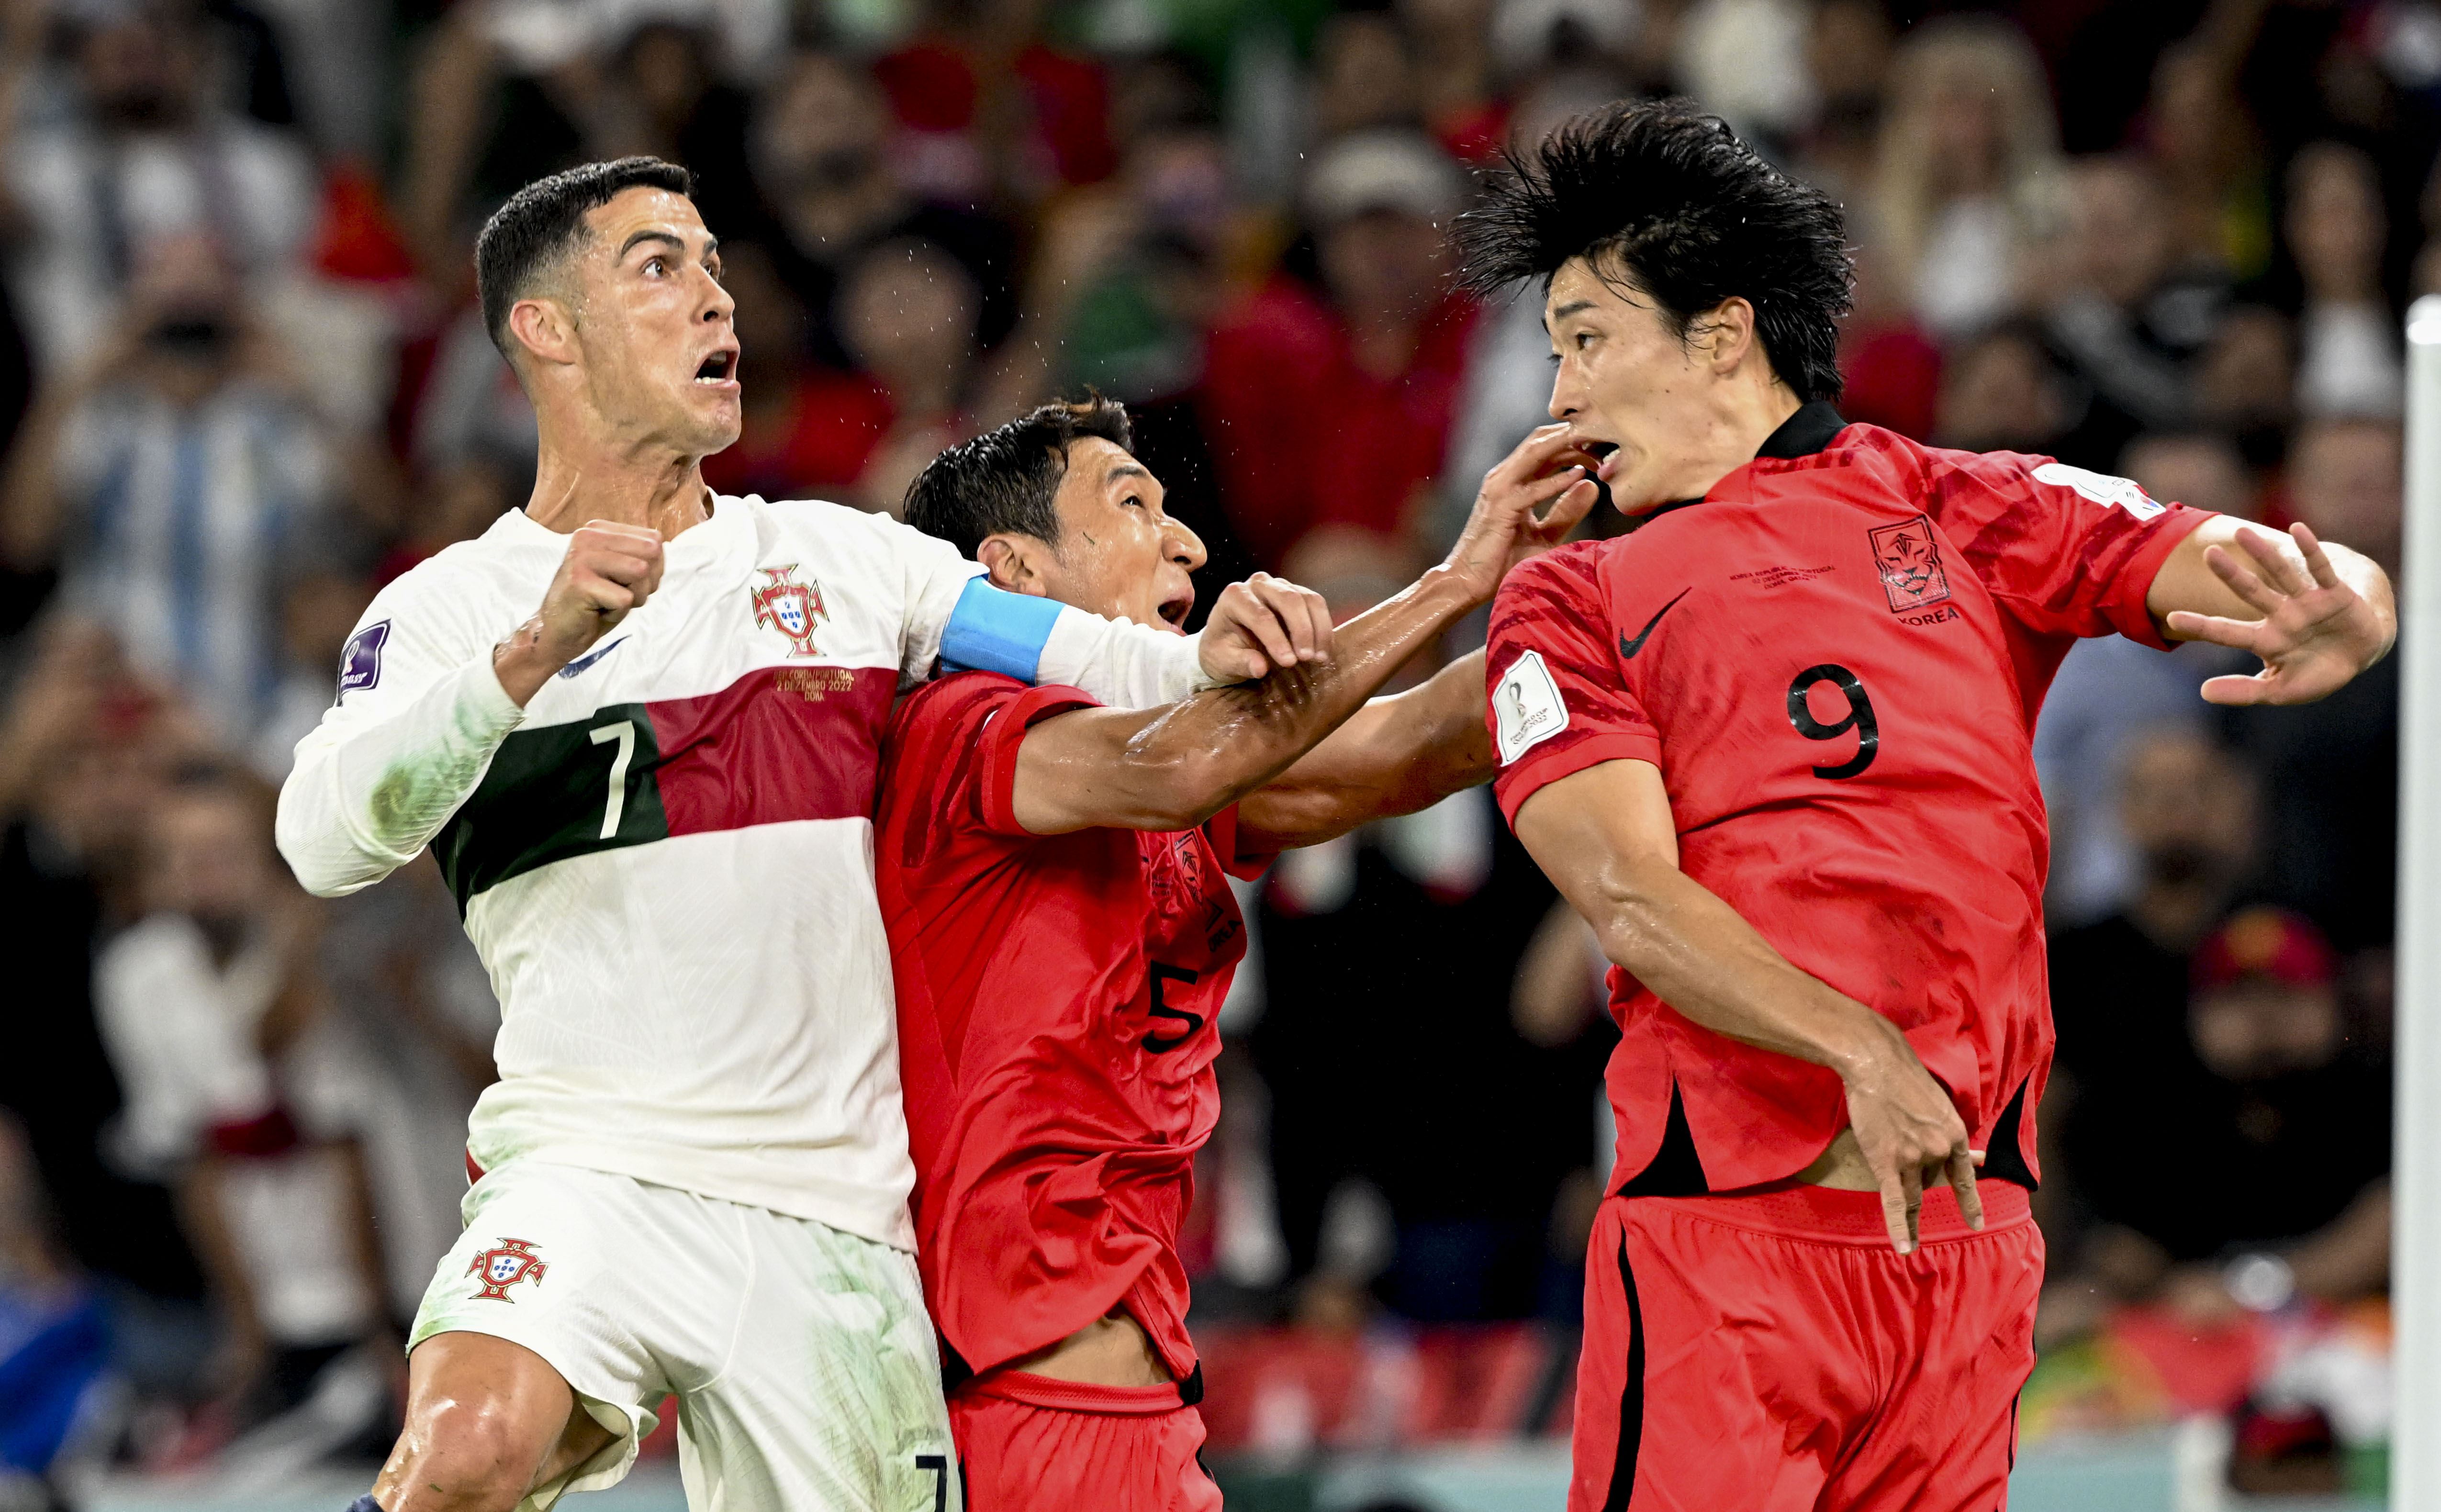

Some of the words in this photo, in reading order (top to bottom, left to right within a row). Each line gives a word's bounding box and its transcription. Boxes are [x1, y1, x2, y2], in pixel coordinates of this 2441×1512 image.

[1897, 607, 1960, 626] KOREA
[777, 680, 782, 692] 2
[828, 679, 851, 692] 2022
[1787, 664, 1879, 780] 9
[589, 719, 635, 840] 7
[1209, 920, 1242, 952] OREA
[1141, 959, 1204, 1054] 5
[916, 1456, 947, 1512] 7
